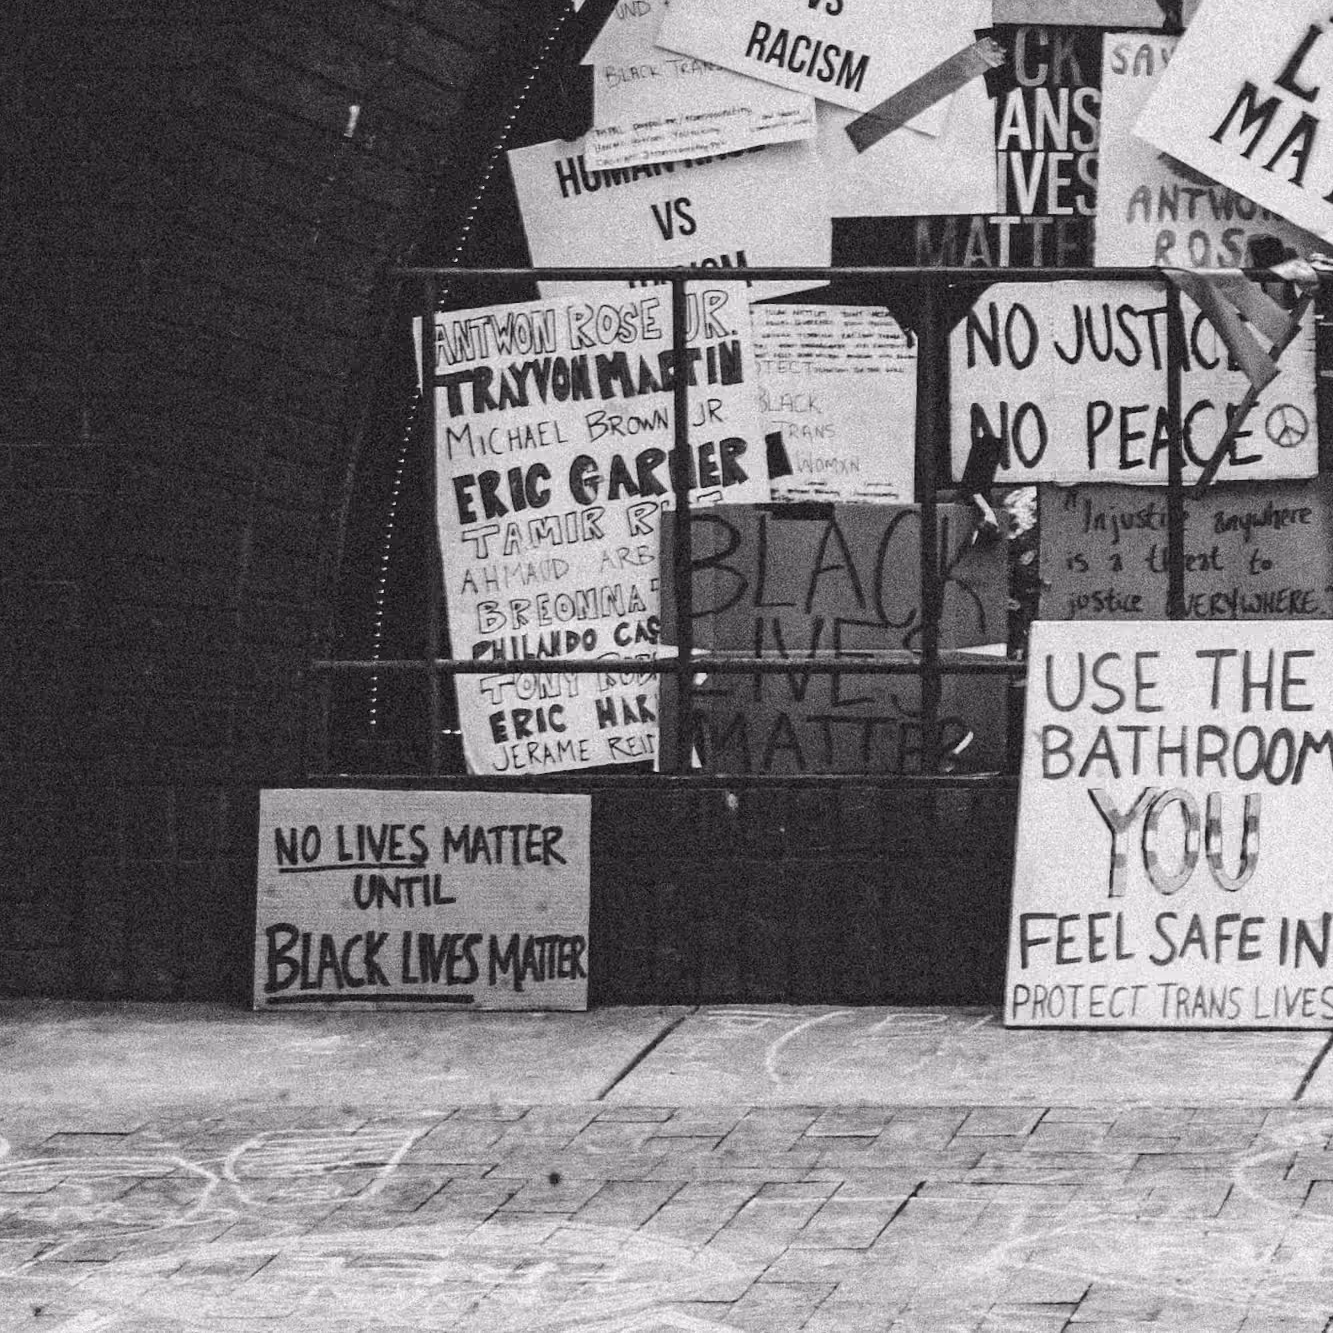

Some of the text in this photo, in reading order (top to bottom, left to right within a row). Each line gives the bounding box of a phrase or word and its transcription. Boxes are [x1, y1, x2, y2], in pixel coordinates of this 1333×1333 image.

[745, 20, 870, 93] RACISM
[434, 298, 663, 367] ANTWON ROSE
[965, 302, 1040, 370] NO
[434, 353, 594, 418] TRAYVON
[600, 339, 744, 402] MARTIN
[446, 407, 670, 461] MICHAEL BROWN
[970, 399, 1264, 471] NO PEACE
[453, 461, 552, 525] ERIC
[461, 507, 607, 560] TAMIR
[478, 584, 647, 635] BREONNA
[1045, 649, 1316, 715] USE THE
[488, 702, 567, 744] ERIC
[493, 734, 592, 773] JERAME
[274, 823, 567, 866] NO LIVES MATTER
[1088, 786, 1262, 898] YOU
[353, 873, 457, 910] UNTIL
[264, 922, 588, 994] BLACK LIVES MATTER
[1019, 911, 1136, 970] FEEL
[1150, 911, 1266, 967] SAFE
[1012, 983, 1147, 1020] PROTECT
[1157, 982, 1242, 1021] TRANS
